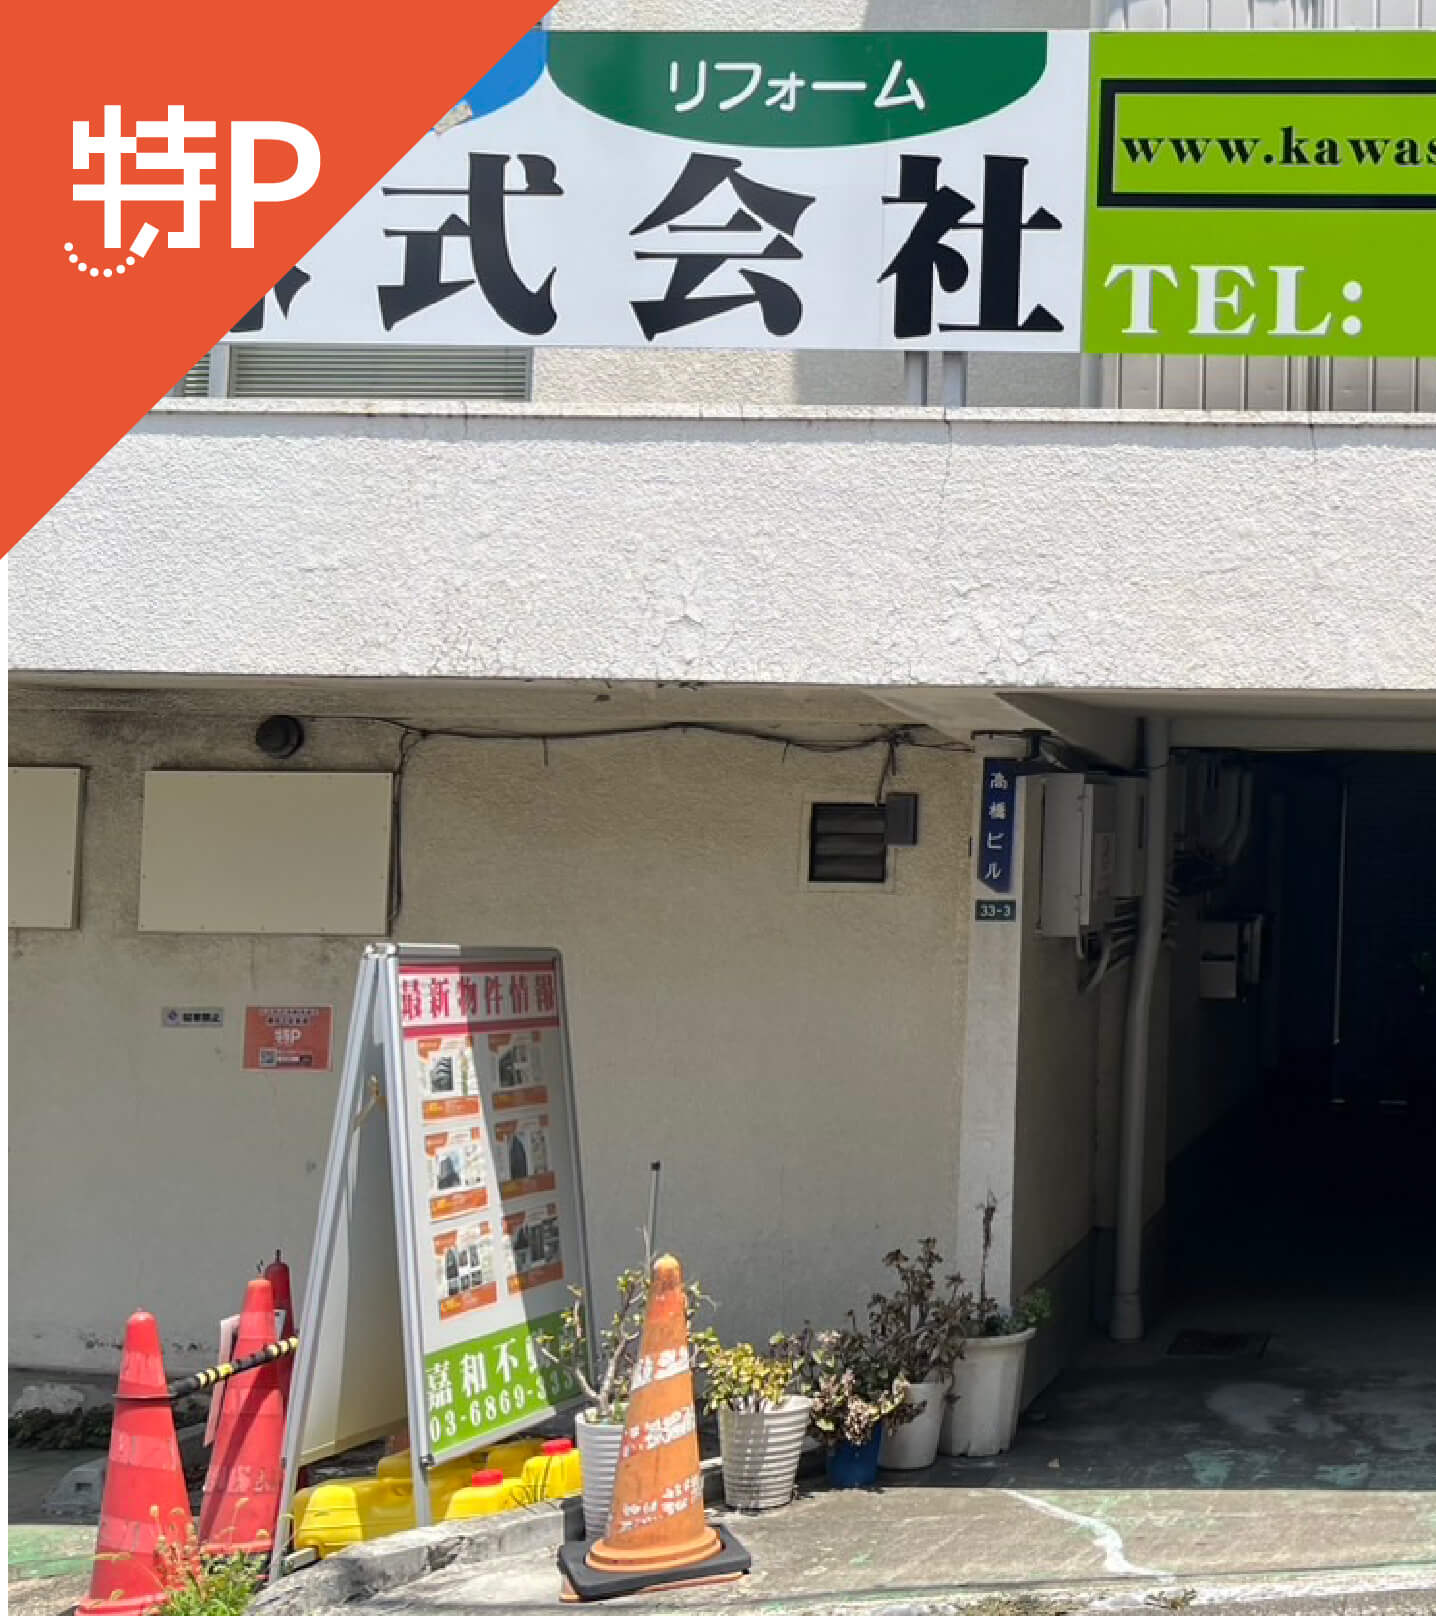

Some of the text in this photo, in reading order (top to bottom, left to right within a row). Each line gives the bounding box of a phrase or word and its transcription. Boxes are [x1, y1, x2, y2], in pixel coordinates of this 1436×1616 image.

[668, 59, 926, 113] リフォーム
[230, 153, 1066, 342] 式会社
[1105, 263, 1367, 338] TEL:
[980, 904, 1011, 917] 33-3
[401, 973, 556, 1020] 最新物件情報
